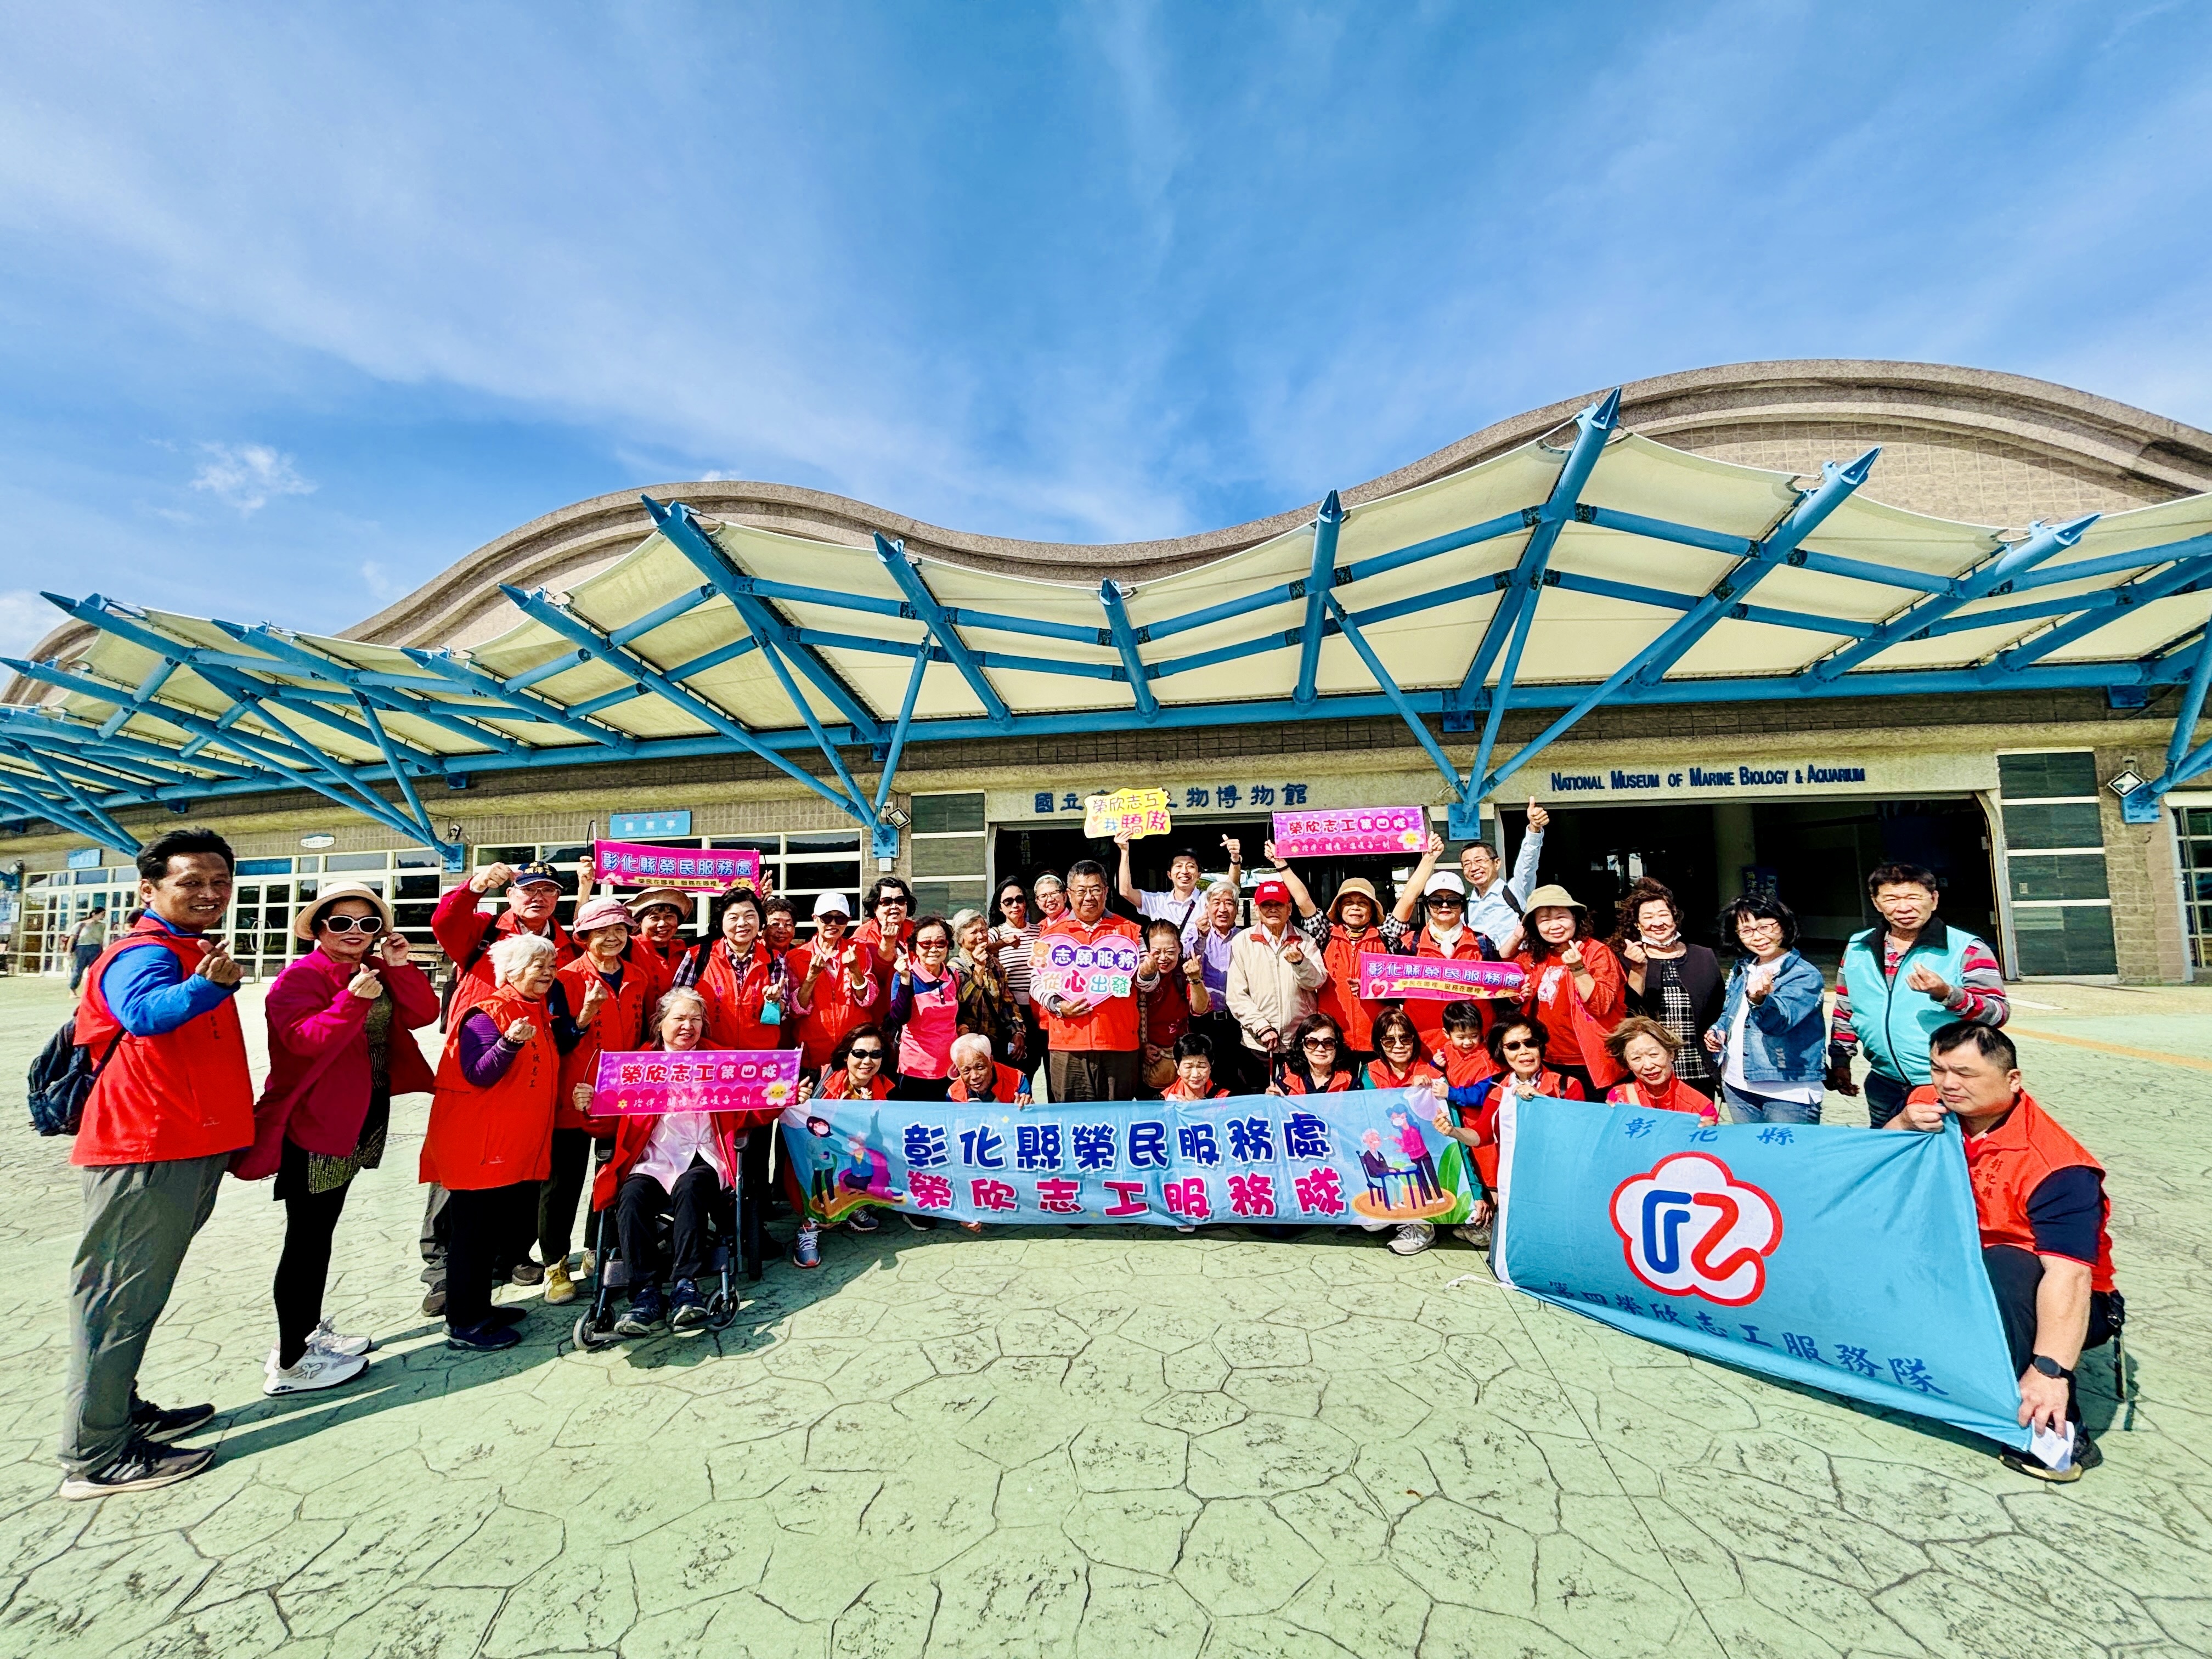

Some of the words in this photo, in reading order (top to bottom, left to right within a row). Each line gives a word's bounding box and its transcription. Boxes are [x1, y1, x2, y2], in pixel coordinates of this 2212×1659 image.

[1551, 772, 1605, 791] NATIONAL
[1611, 770, 1660, 789] MUSEUM
[1690, 768, 1735, 786] MARINE
[1739, 766, 1788, 785] BIOLOGY
[1795, 770, 1803, 783] &
[1808, 764, 1866, 783] AQUARIUM
[1035, 784, 1308, 813] 國立物博物館
[1093, 792, 1160, 814] 榮欣志工
[601, 851, 753, 877] 彰化縣榮民服務處
[1054, 947, 1136, 969] 志願服務
[1043, 969, 1129, 995] 從心出發
[1368, 962, 1523, 987] 彰化縣榮民服務處
[621, 1063, 781, 1085] 榮欣志工第四隊
[902, 1111, 1333, 1171] 彰化縣榮民服務處
[1624, 1117, 1795, 1146] 彰化縣
[907, 1166, 1346, 1219] 榮欣志工服務隊
